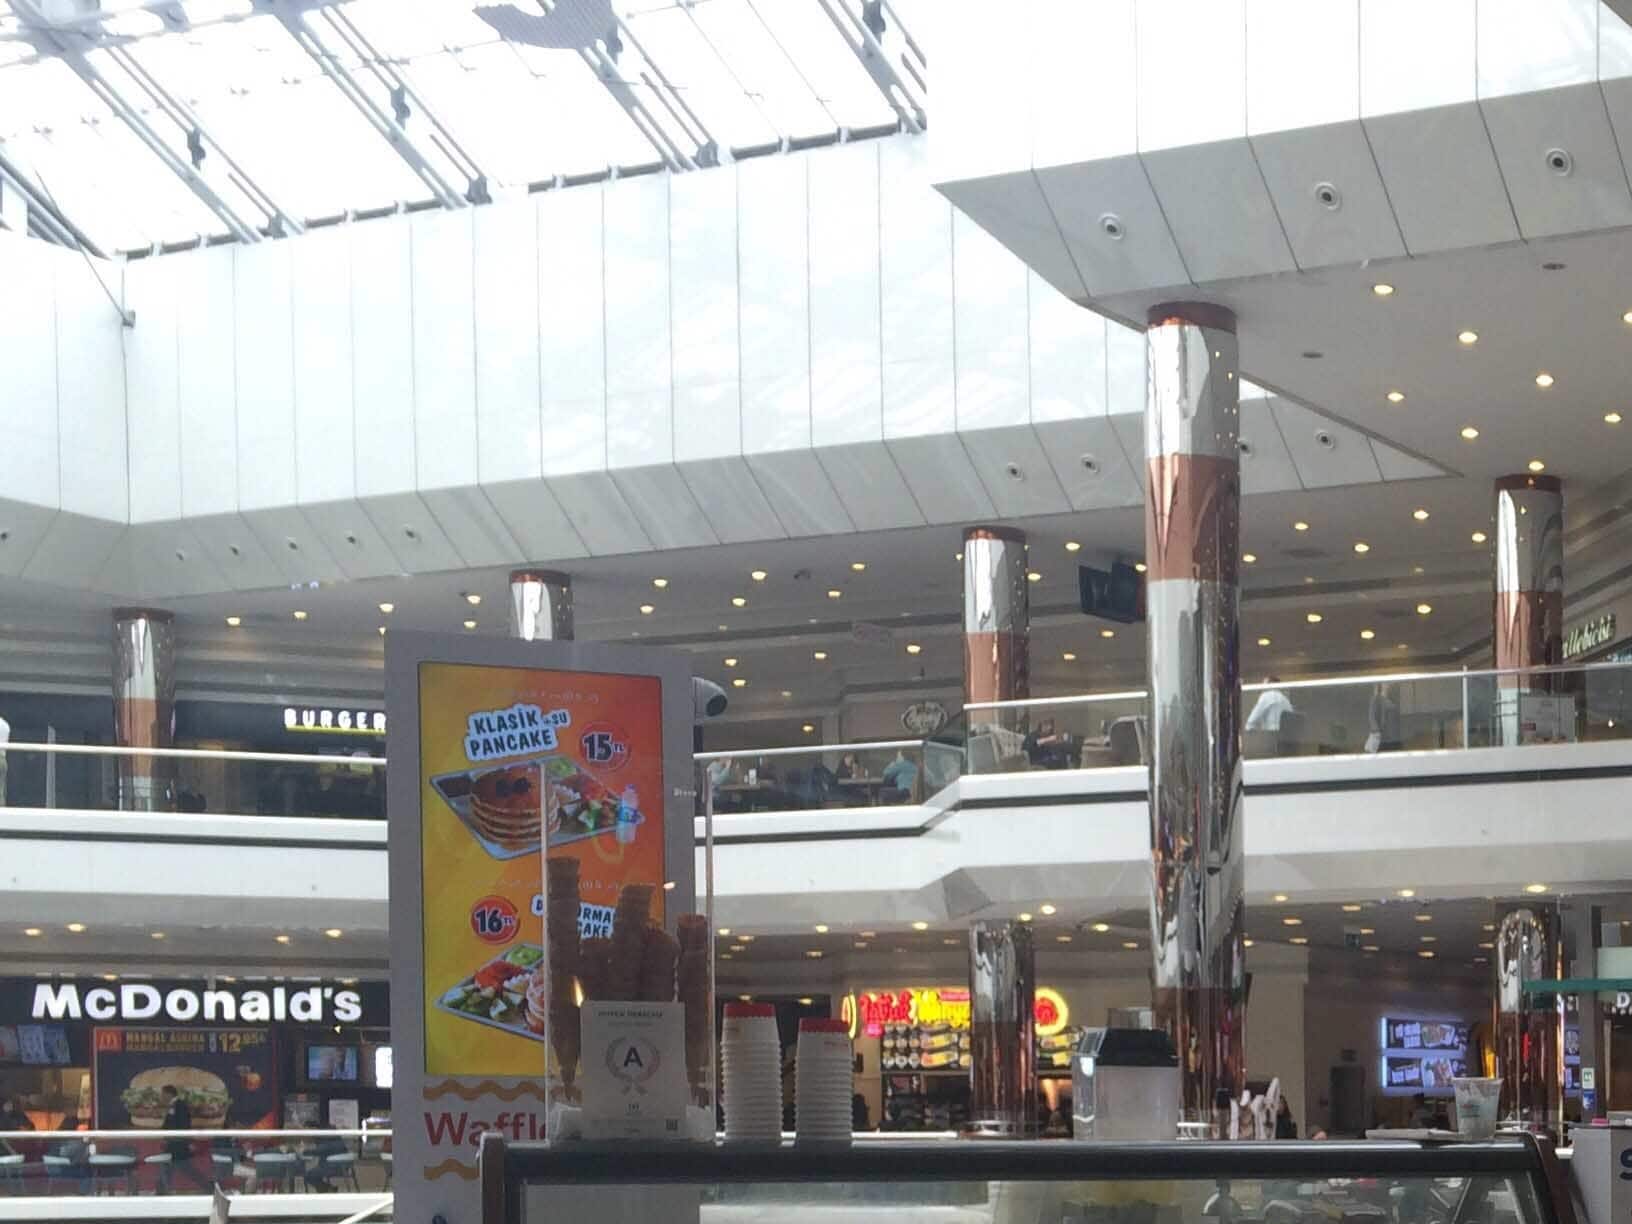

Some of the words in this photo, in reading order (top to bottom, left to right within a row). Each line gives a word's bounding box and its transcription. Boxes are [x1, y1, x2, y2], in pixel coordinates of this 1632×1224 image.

[284, 708, 386, 730] BURGER
[473, 707, 539, 734] KLASİK
[469, 730, 553, 757] PANCAKE
[583, 732, 612, 760] 15
[474, 908, 501, 933] 16
[32, 984, 362, 1021] McDonald's
[623, 1047, 643, 1067] A
[424, 1112, 546, 1146] Waffl
